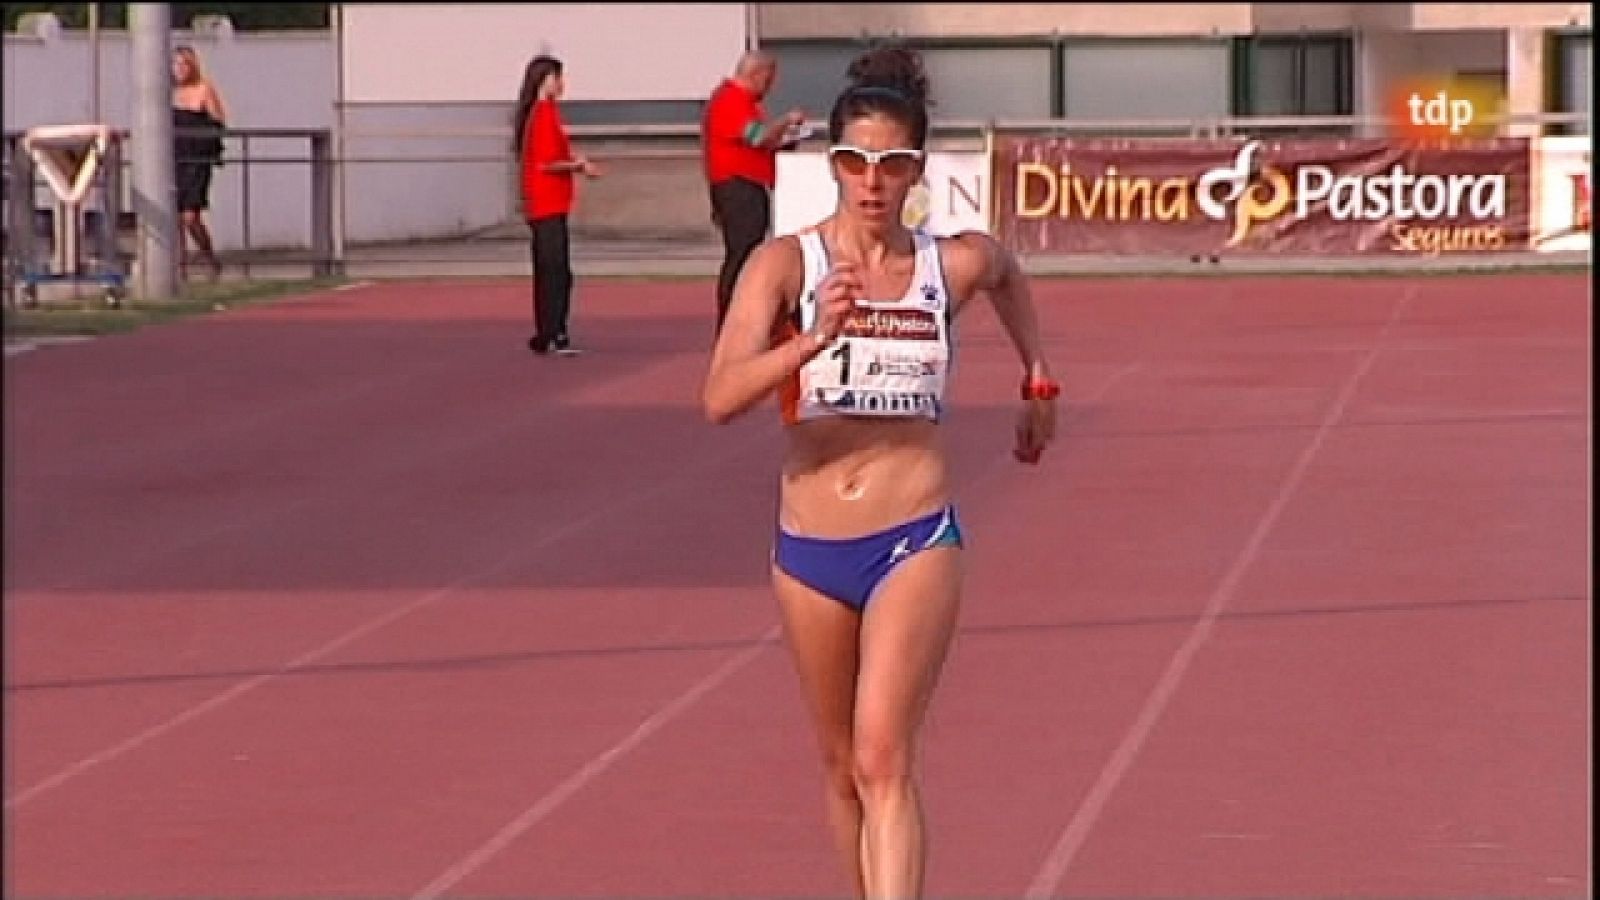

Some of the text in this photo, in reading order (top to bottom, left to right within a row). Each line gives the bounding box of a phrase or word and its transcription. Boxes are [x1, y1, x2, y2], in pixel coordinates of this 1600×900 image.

[1016, 162, 1189, 220] Divina
[1296, 164, 1506, 219] Pastora
[1391, 225, 1506, 256] Seguros
[831, 342, 851, 386] 1
